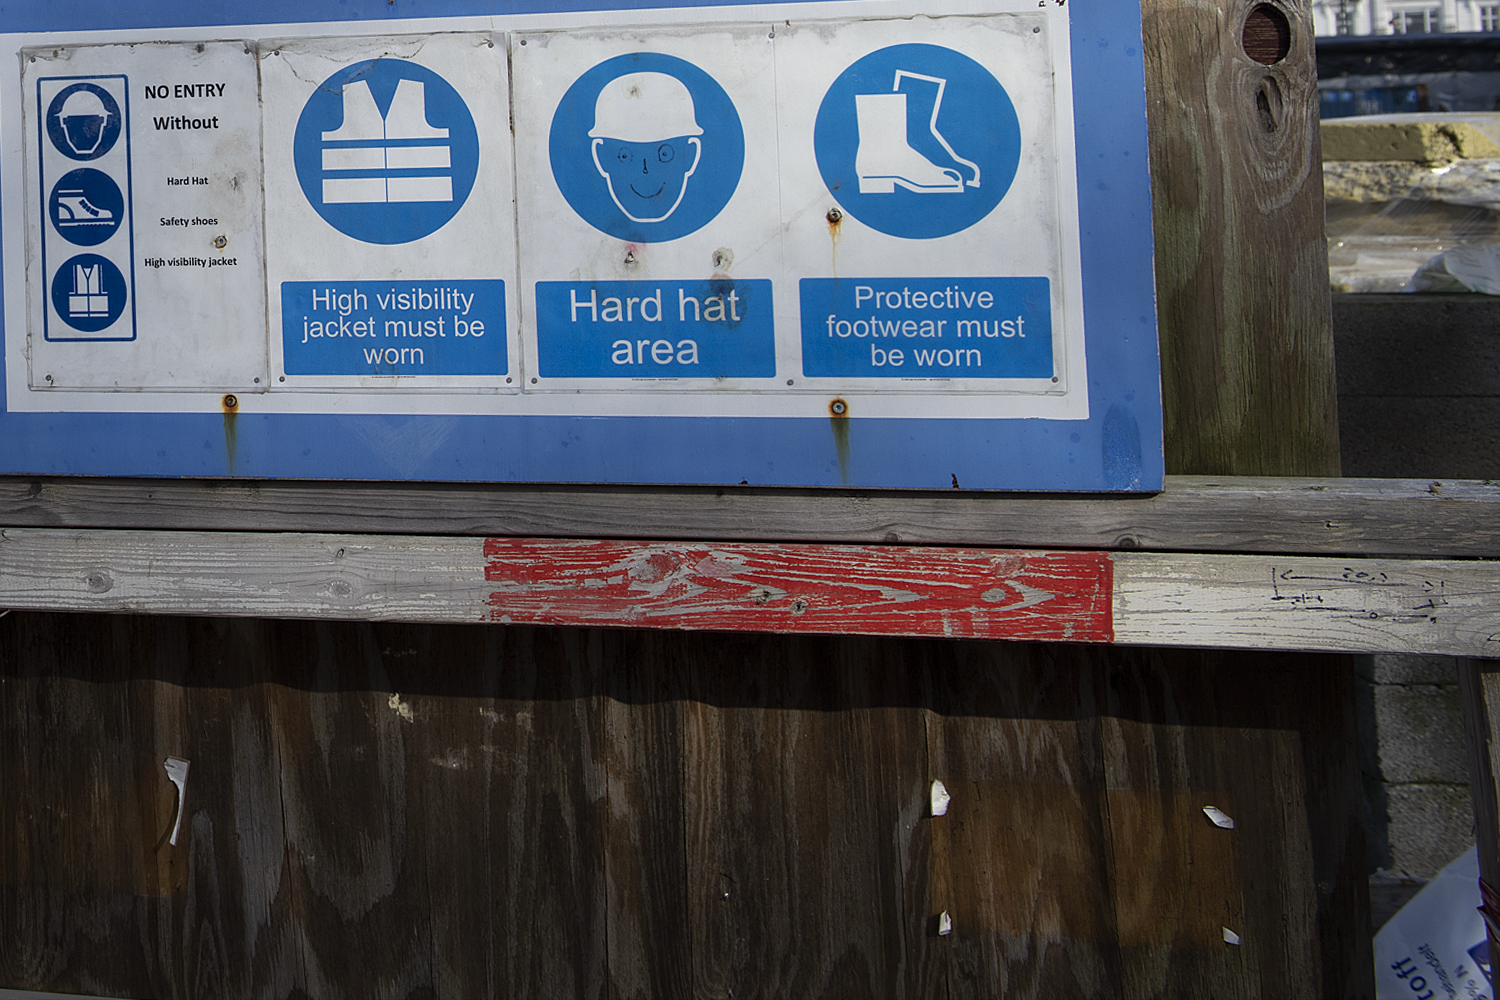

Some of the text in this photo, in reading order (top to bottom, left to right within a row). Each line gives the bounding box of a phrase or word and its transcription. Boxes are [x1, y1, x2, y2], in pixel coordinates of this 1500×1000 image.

[144, 83, 226, 99] NO ENTRY
[153, 115, 219, 130] Without
[167, 176, 209, 186] Hard Hat
[160, 216, 219, 228] Safety shoes
[144, 256, 237, 269] High visibility jacket
[312, 288, 475, 317] High visibility
[569, 288, 741, 323] Hard hat
[854, 285, 994, 309] Protective
[302, 316, 485, 343] jacket must be
[825, 314, 1026, 339] footwear must
[363, 347, 424, 365] worn
[610, 338, 700, 366] area
[871, 342, 983, 368] be worn
